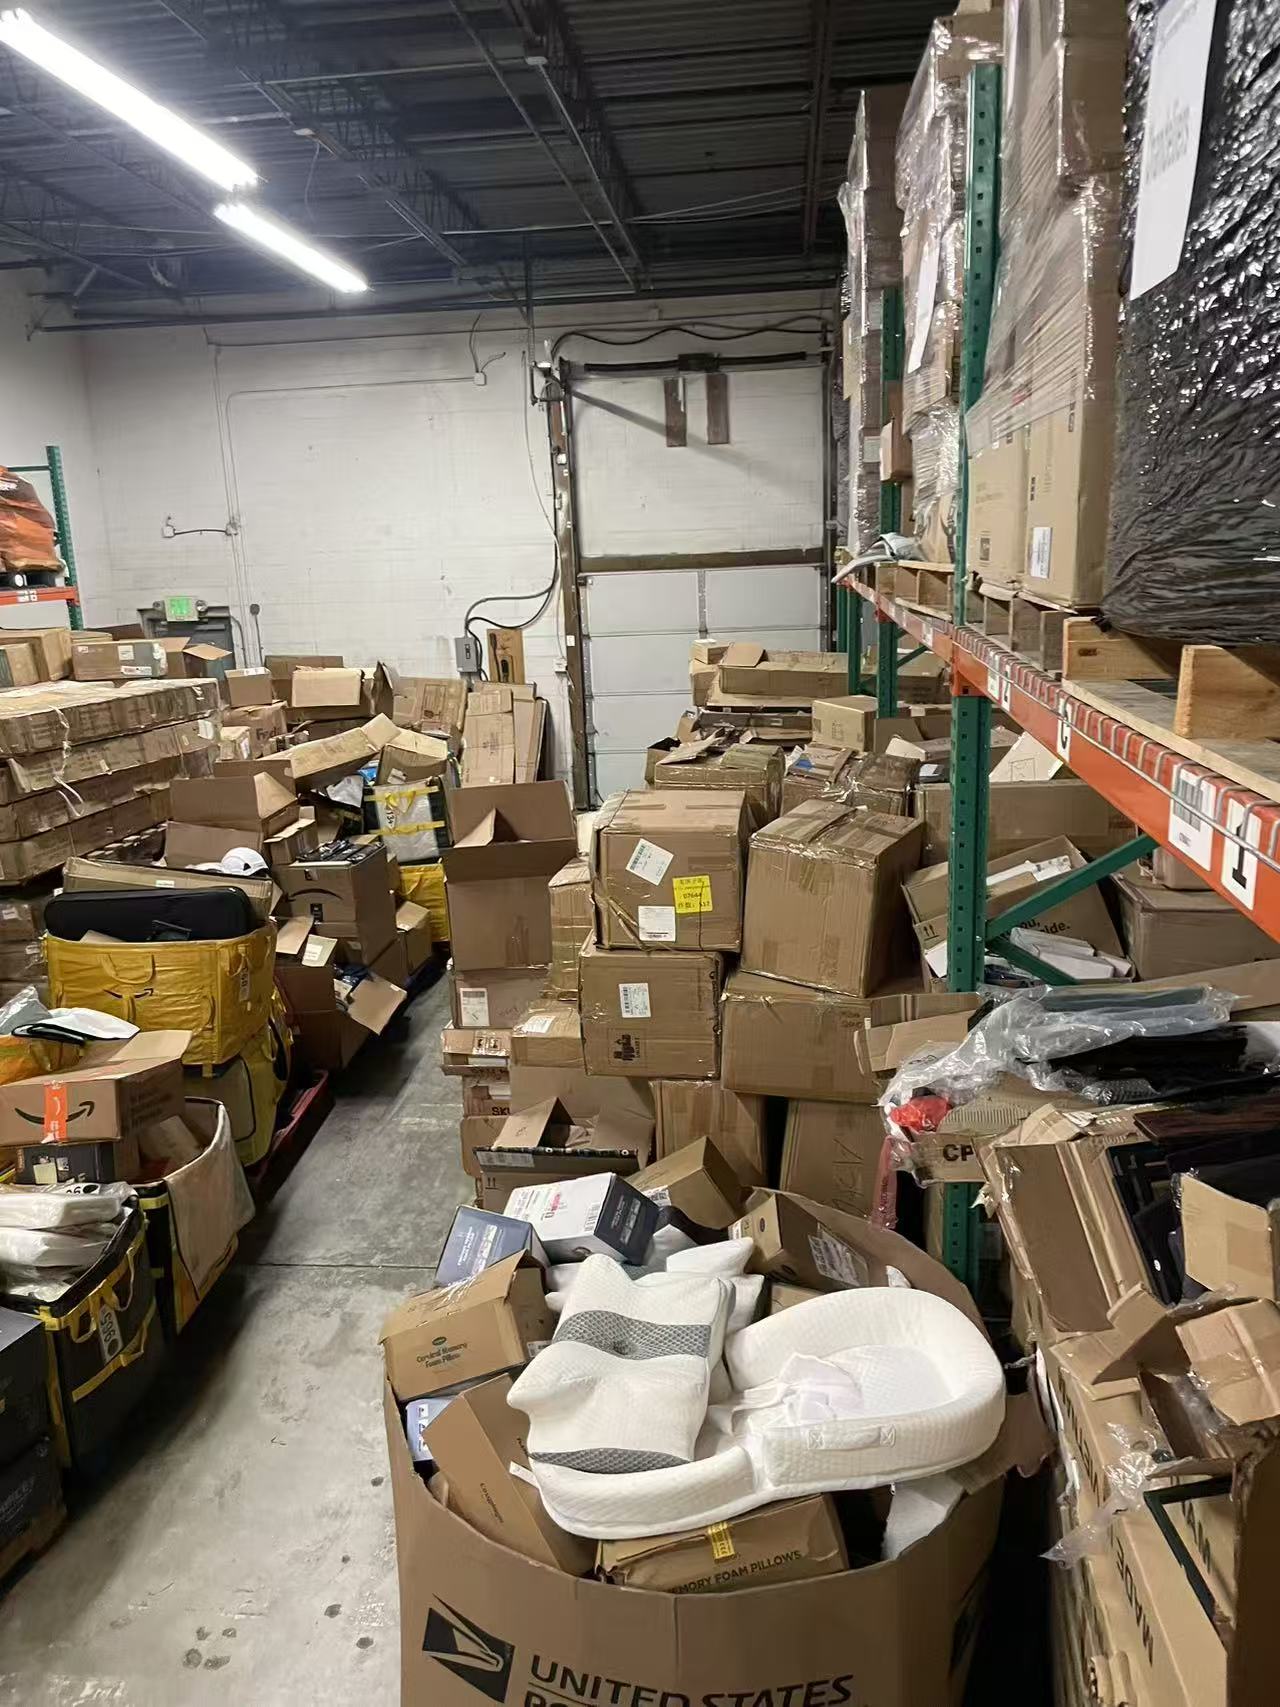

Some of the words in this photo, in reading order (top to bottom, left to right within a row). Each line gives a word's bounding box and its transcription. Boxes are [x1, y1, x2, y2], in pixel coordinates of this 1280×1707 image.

[714, 1564, 749, 1582] FOAM
[750, 1549, 802, 1574] PILLOWS
[531, 1654, 690, 1707] UNITED
